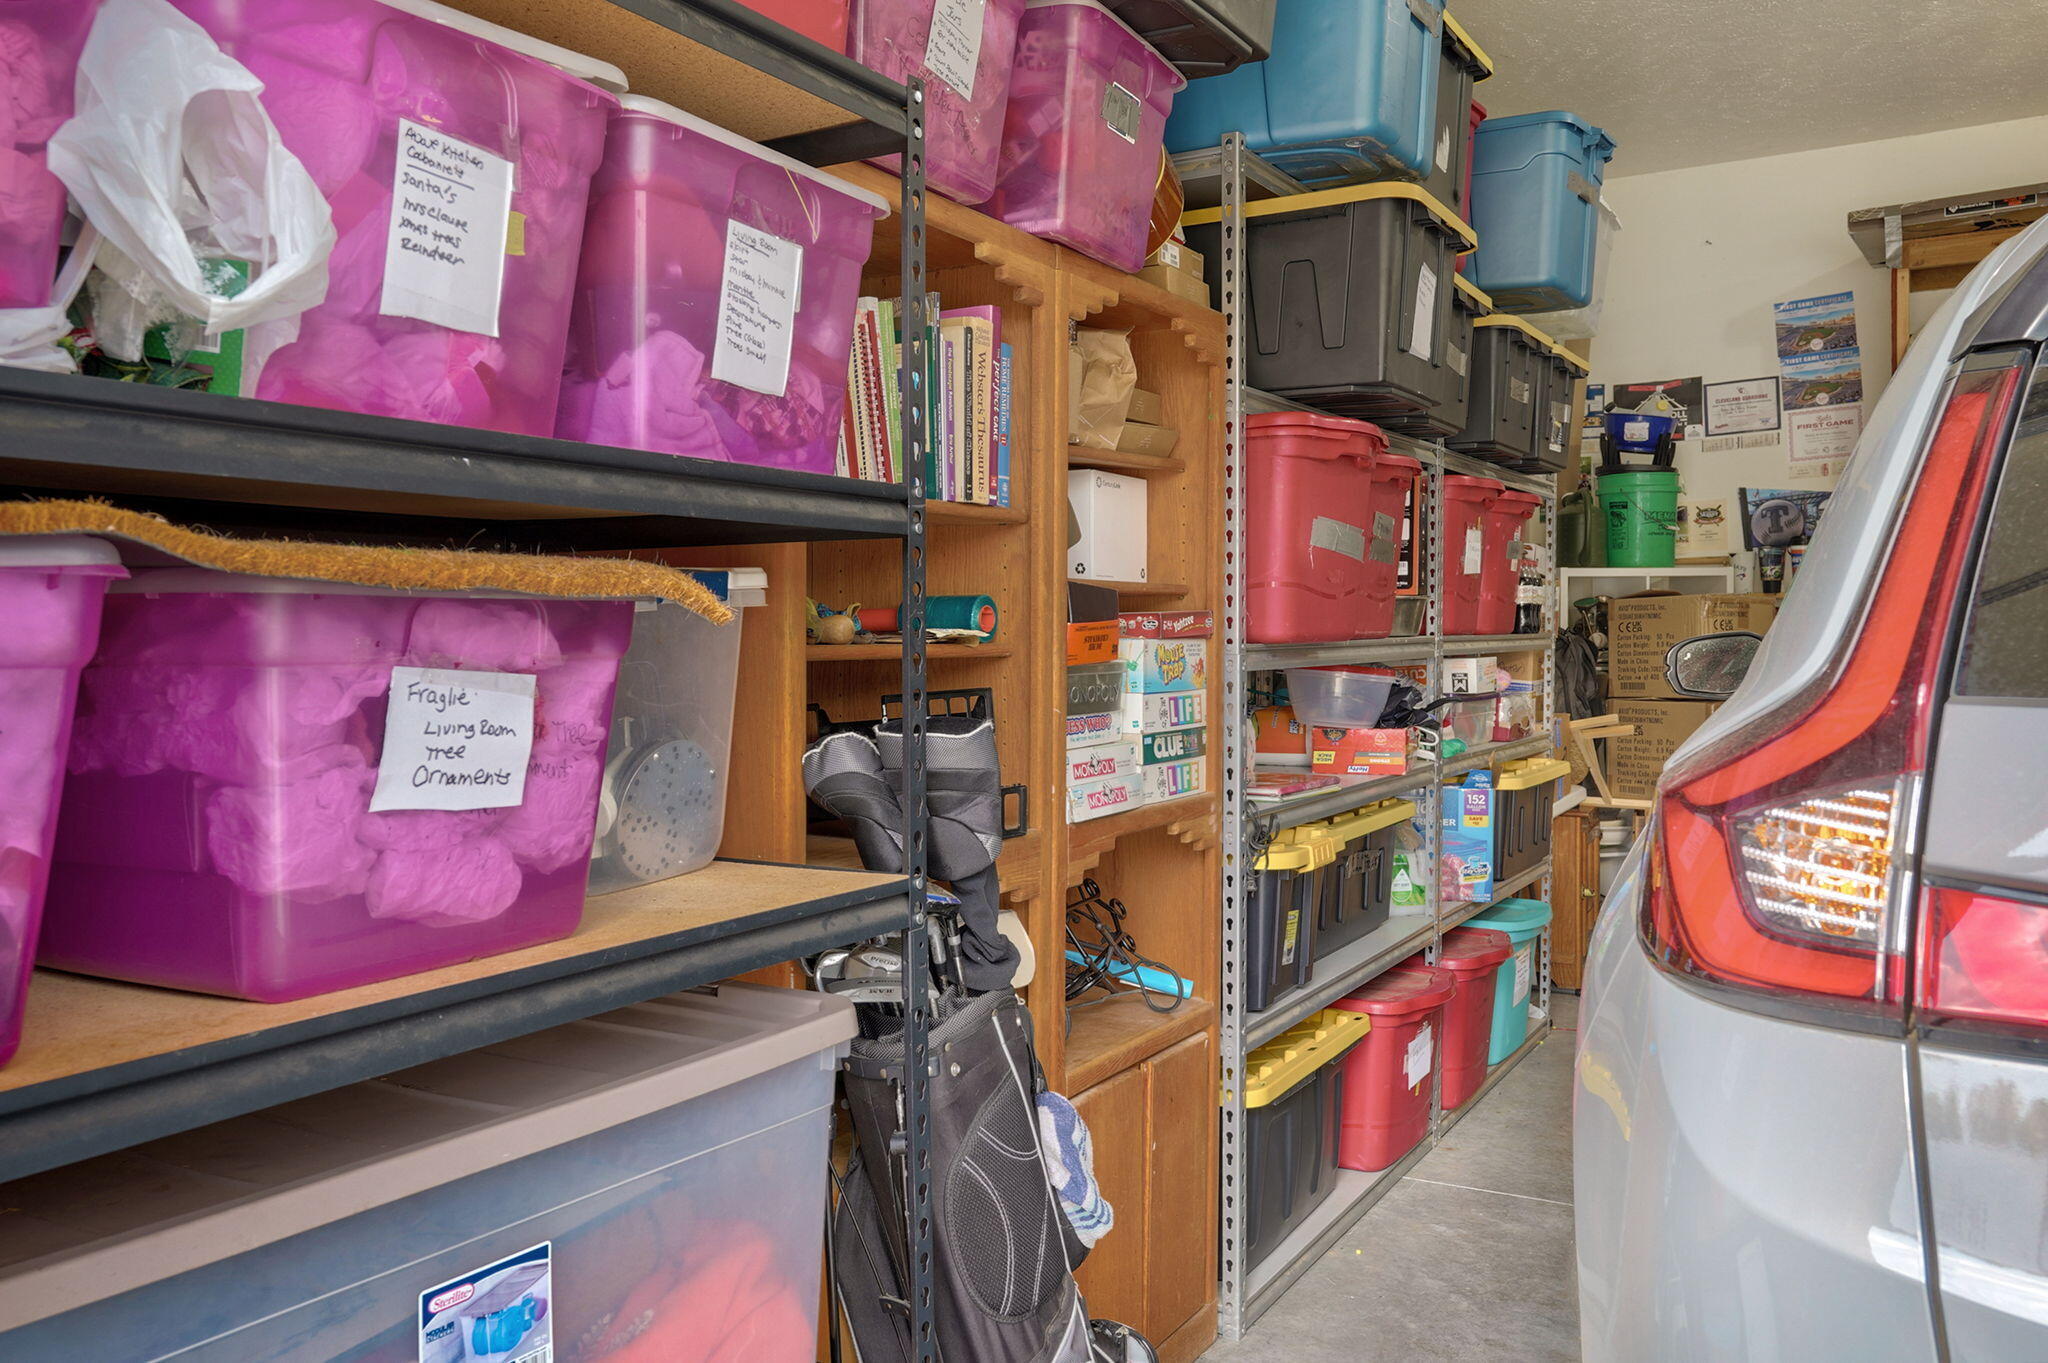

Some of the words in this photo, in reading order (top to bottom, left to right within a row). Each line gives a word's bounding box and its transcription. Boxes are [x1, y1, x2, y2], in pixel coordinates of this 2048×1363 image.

[977, 352, 986, 414] Webster's
[1826, 419, 1854, 427] GAME
[977, 417, 986, 493] Thesaurus
[1069, 684, 1120, 703] ONOPOLY
[1170, 695, 1202, 726] LIFE
[424, 721, 475, 739] Living
[480, 719, 517, 737] Room
[1087, 715, 1112, 732] WHO?
[1154, 735, 1184, 759] CLUE
[412, 765, 511, 788] Ornaments
[1168, 763, 1199, 794] LIFE
[1467, 794, 1485, 804] 152
[433, 1288, 472, 1311] Sterilite
